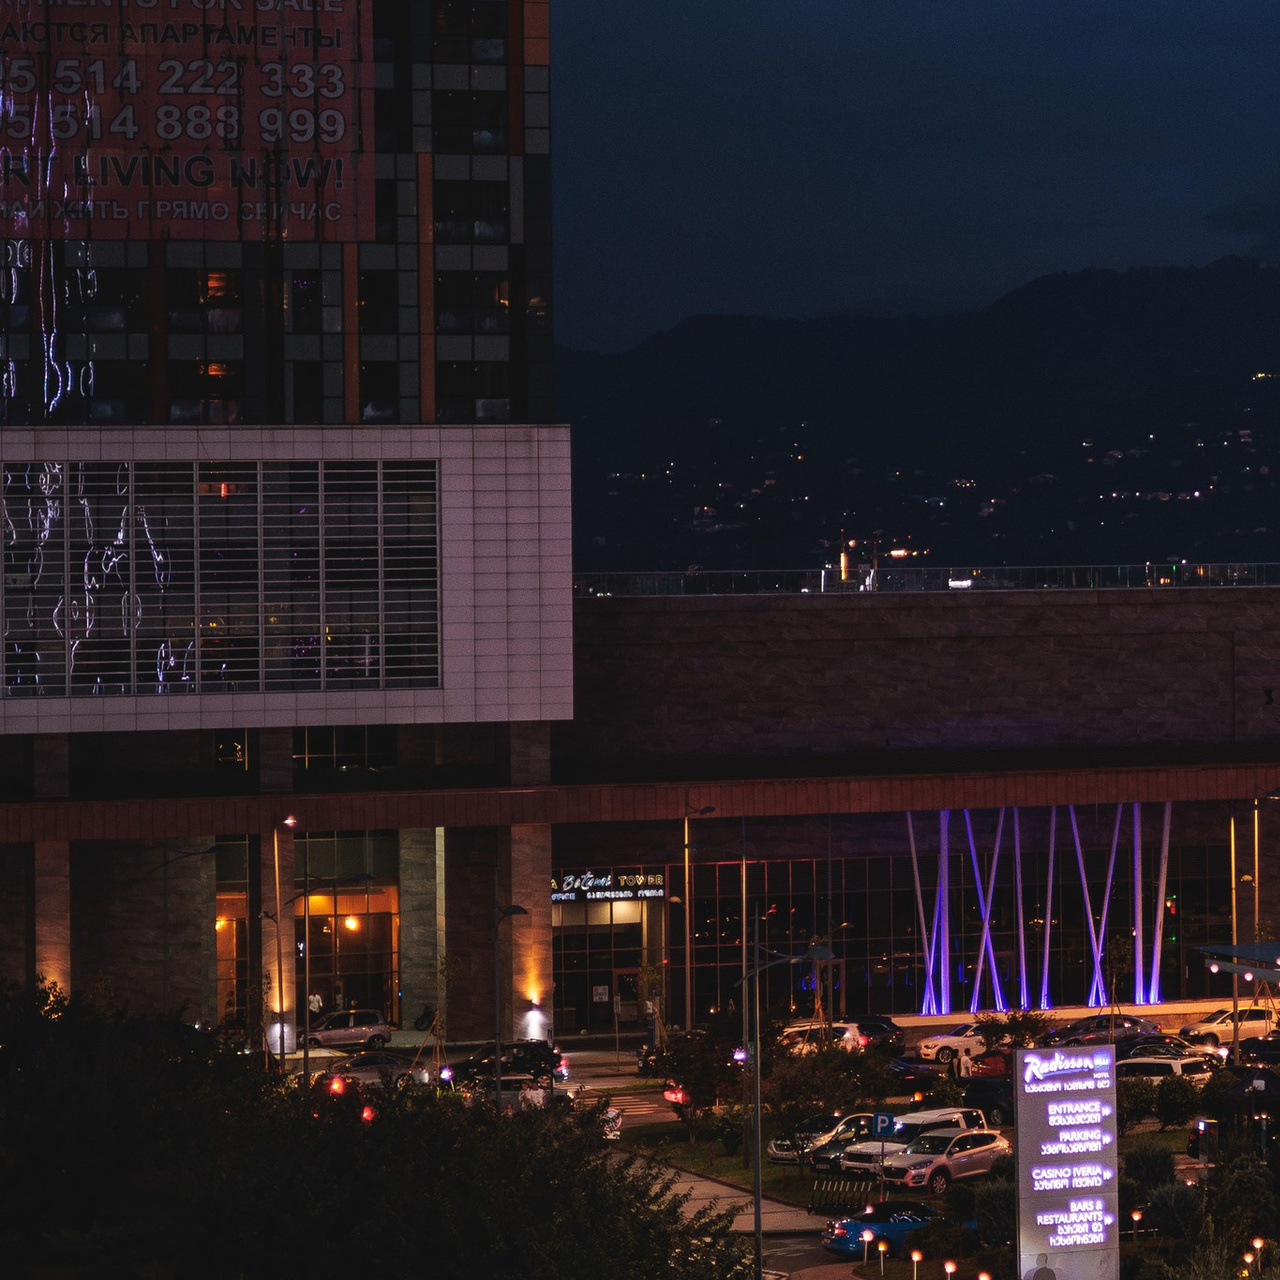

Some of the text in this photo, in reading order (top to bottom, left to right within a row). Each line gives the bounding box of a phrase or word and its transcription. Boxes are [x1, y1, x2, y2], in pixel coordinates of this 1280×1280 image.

[1, 22, 341, 48] АЮТСЯ АПАРТАМЕНТЫ
[0, 58, 346, 99] 5 514 222 333
[0, 104, 346, 144] 5 514 888 999
[73, 154, 215, 187] LIVING
[229, 157, 344, 189] NOW!
[618, 874, 664, 887] TOWER
[1024, 1051, 1094, 1083] Radisson
[1048, 1101, 1101, 1115] ENTRANCE
[1059, 1130, 1101, 1142] PARKING
[1032, 1166, 1102, 1180] CASINO IVERIA
[1070, 1200, 1094, 1212] BARS
[1037, 1211, 1103, 1226] RESTAURANTS
